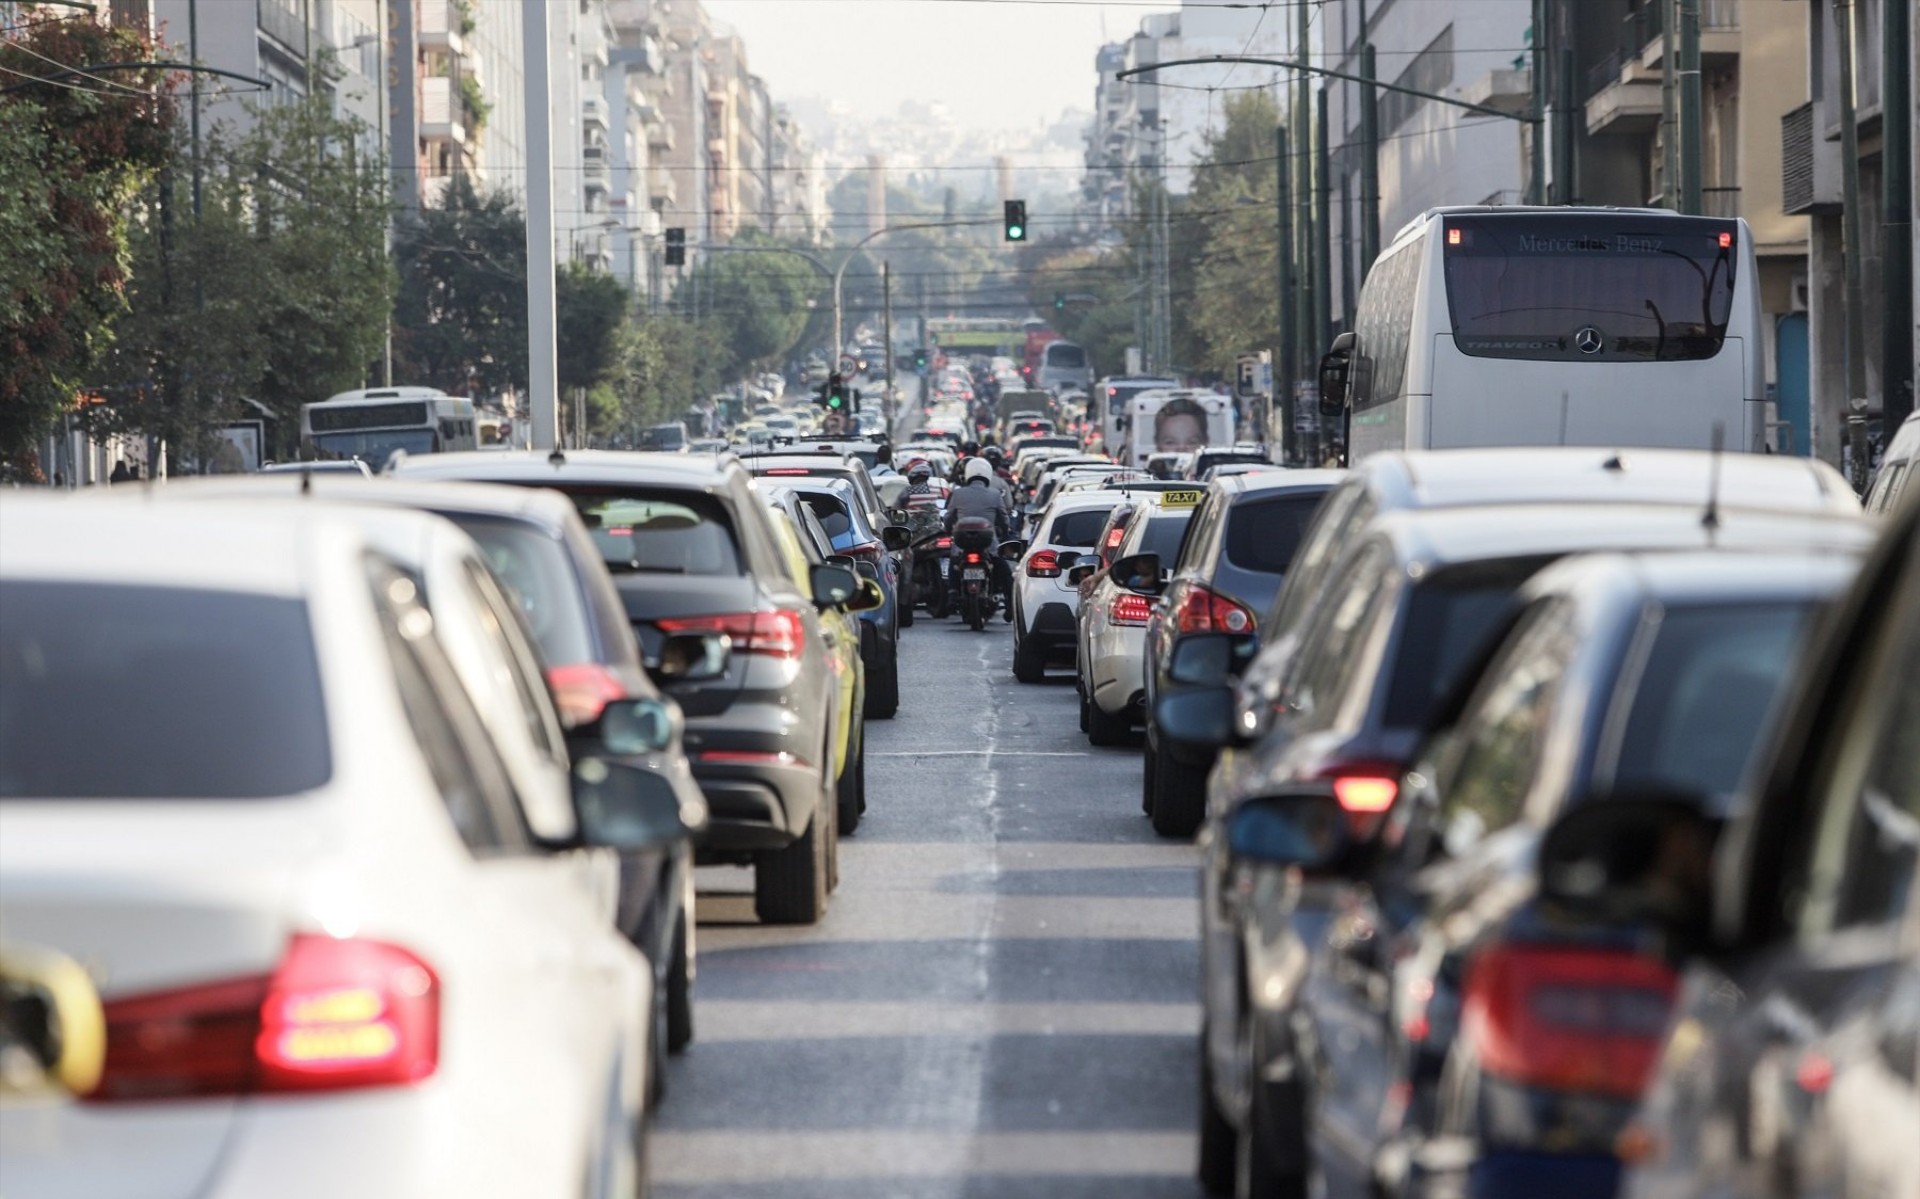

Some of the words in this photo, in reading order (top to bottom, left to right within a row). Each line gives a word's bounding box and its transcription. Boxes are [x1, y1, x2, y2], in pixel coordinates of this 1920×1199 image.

[1519, 234, 1610, 252] Mercedes
[1616, 234, 1664, 252] Benz
[1166, 493, 1195, 502] TAXI
